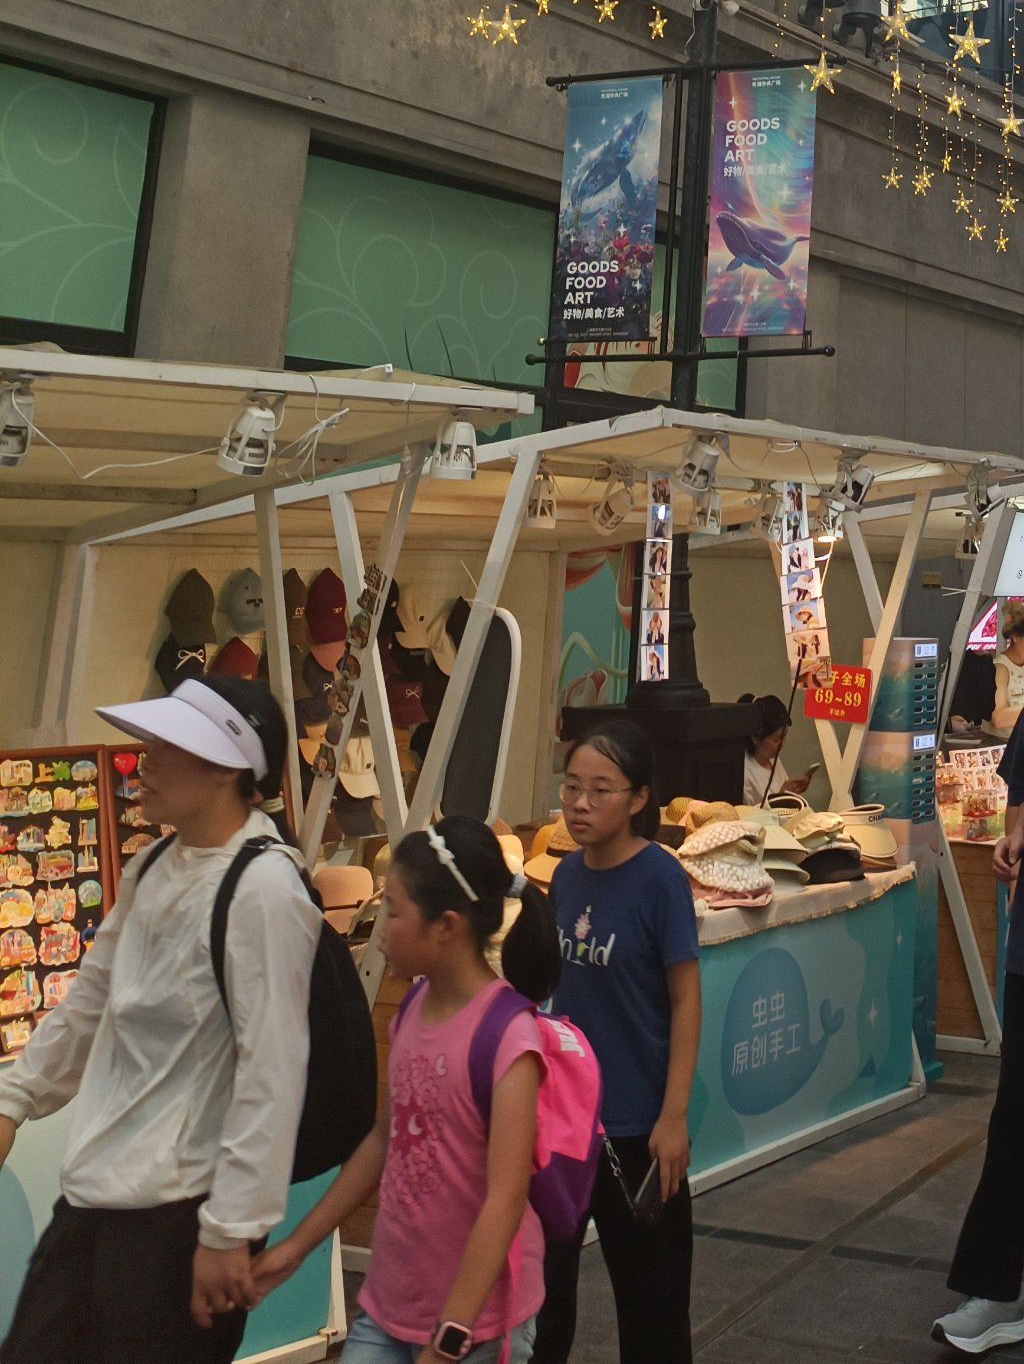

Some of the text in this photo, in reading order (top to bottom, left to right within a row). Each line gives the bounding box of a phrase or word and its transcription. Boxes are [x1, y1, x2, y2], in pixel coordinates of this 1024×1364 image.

[726, 117, 781, 133] GOODS
[724, 133, 768, 148] FOOD
[723, 148, 756, 163] ART
[566, 260, 619, 275] GOODS
[565, 275, 607, 290] FOOD
[563, 291, 594, 305] ART
[562, 306, 625, 320] 好物/美食/艺术
[831, 670, 867, 688] 子全场
[868, 814, 884, 823] CHA
[751, 989, 786, 1029] 虫虫
[731, 1023, 802, 1077] 原创手工
